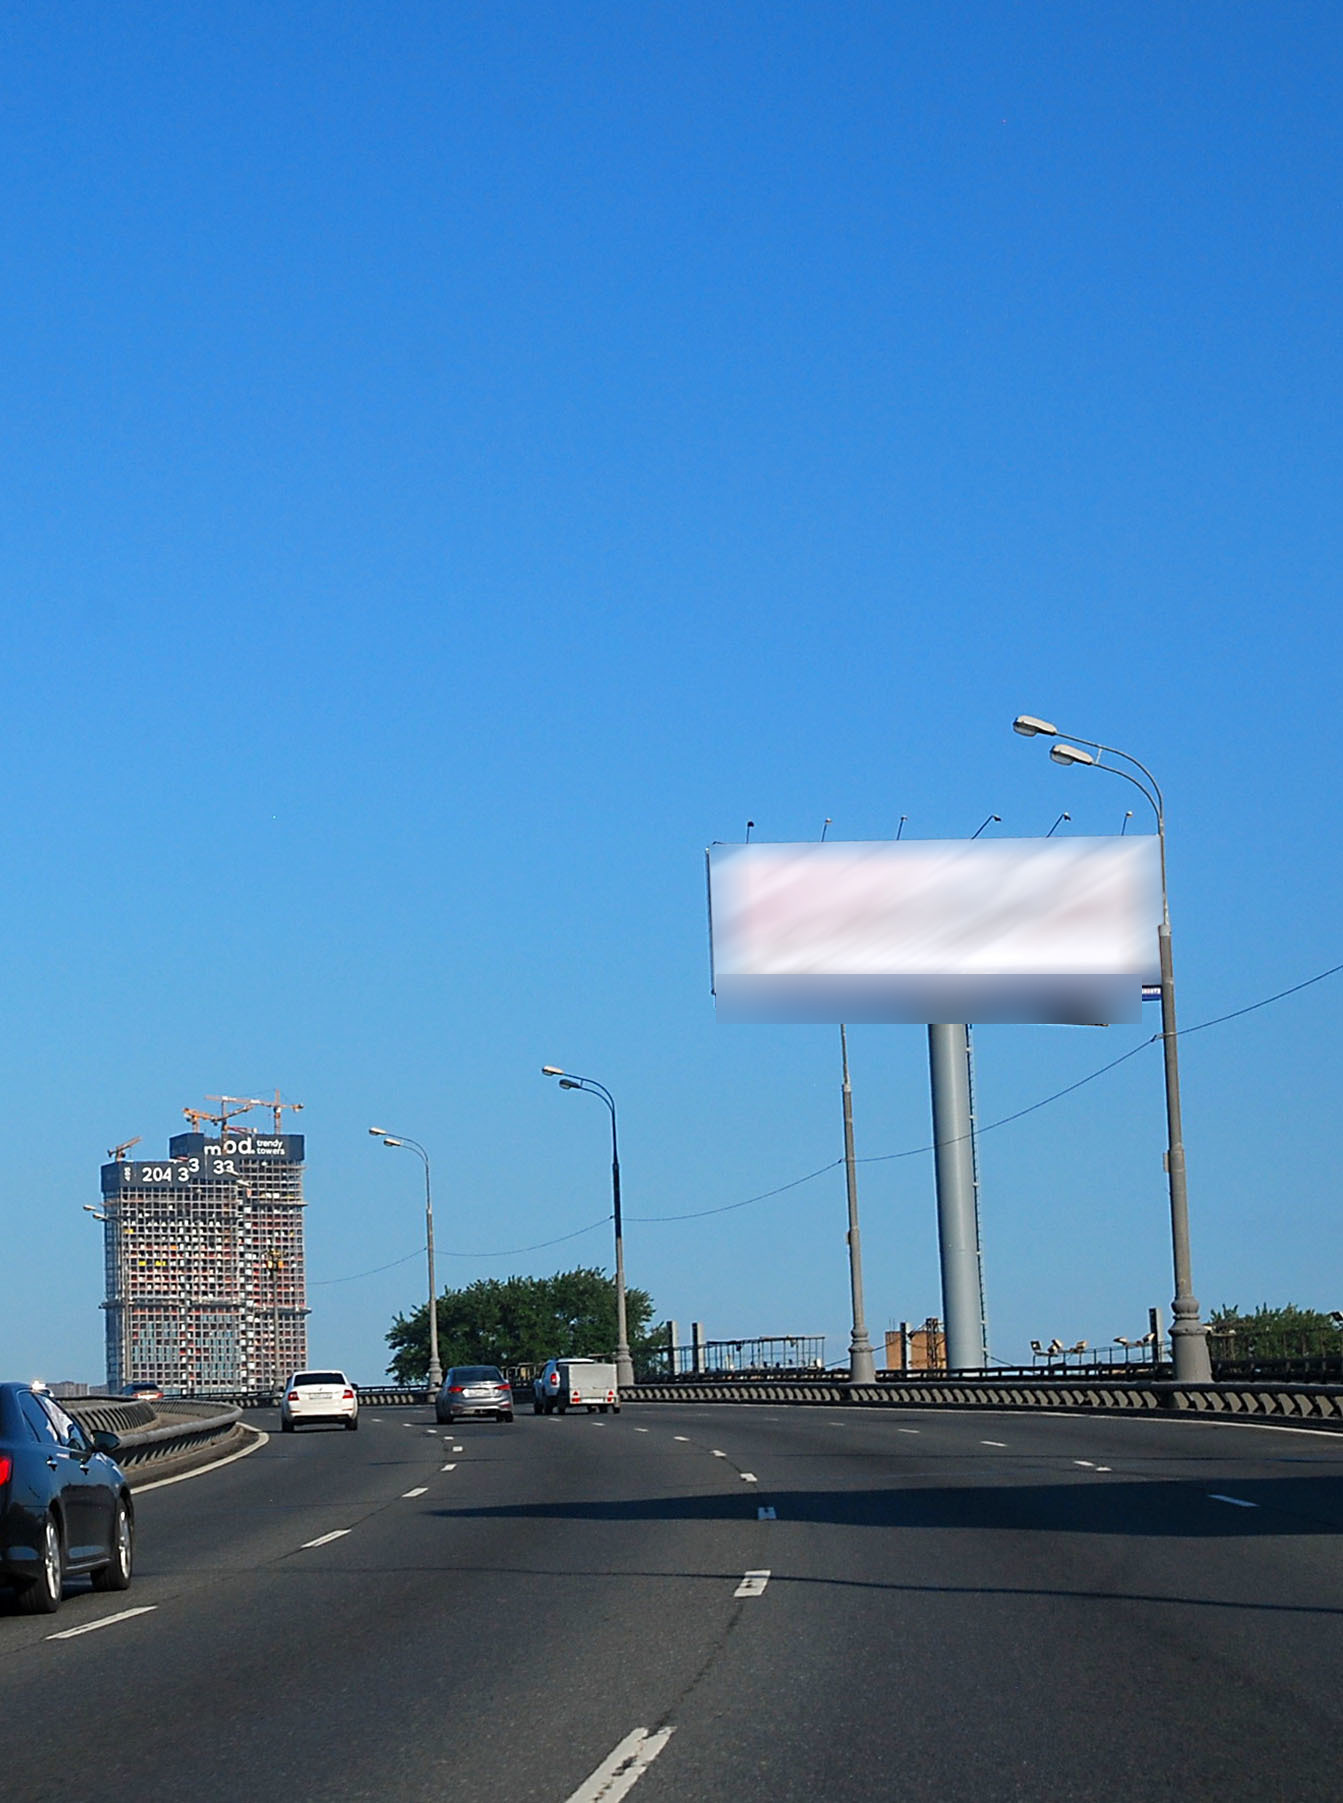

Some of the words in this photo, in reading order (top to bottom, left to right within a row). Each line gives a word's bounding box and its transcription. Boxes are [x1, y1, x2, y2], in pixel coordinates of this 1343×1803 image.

[256, 1139, 283, 1148] trendy
[256, 1147, 285, 1155] towers
[142, 1167, 172, 1182] 204
